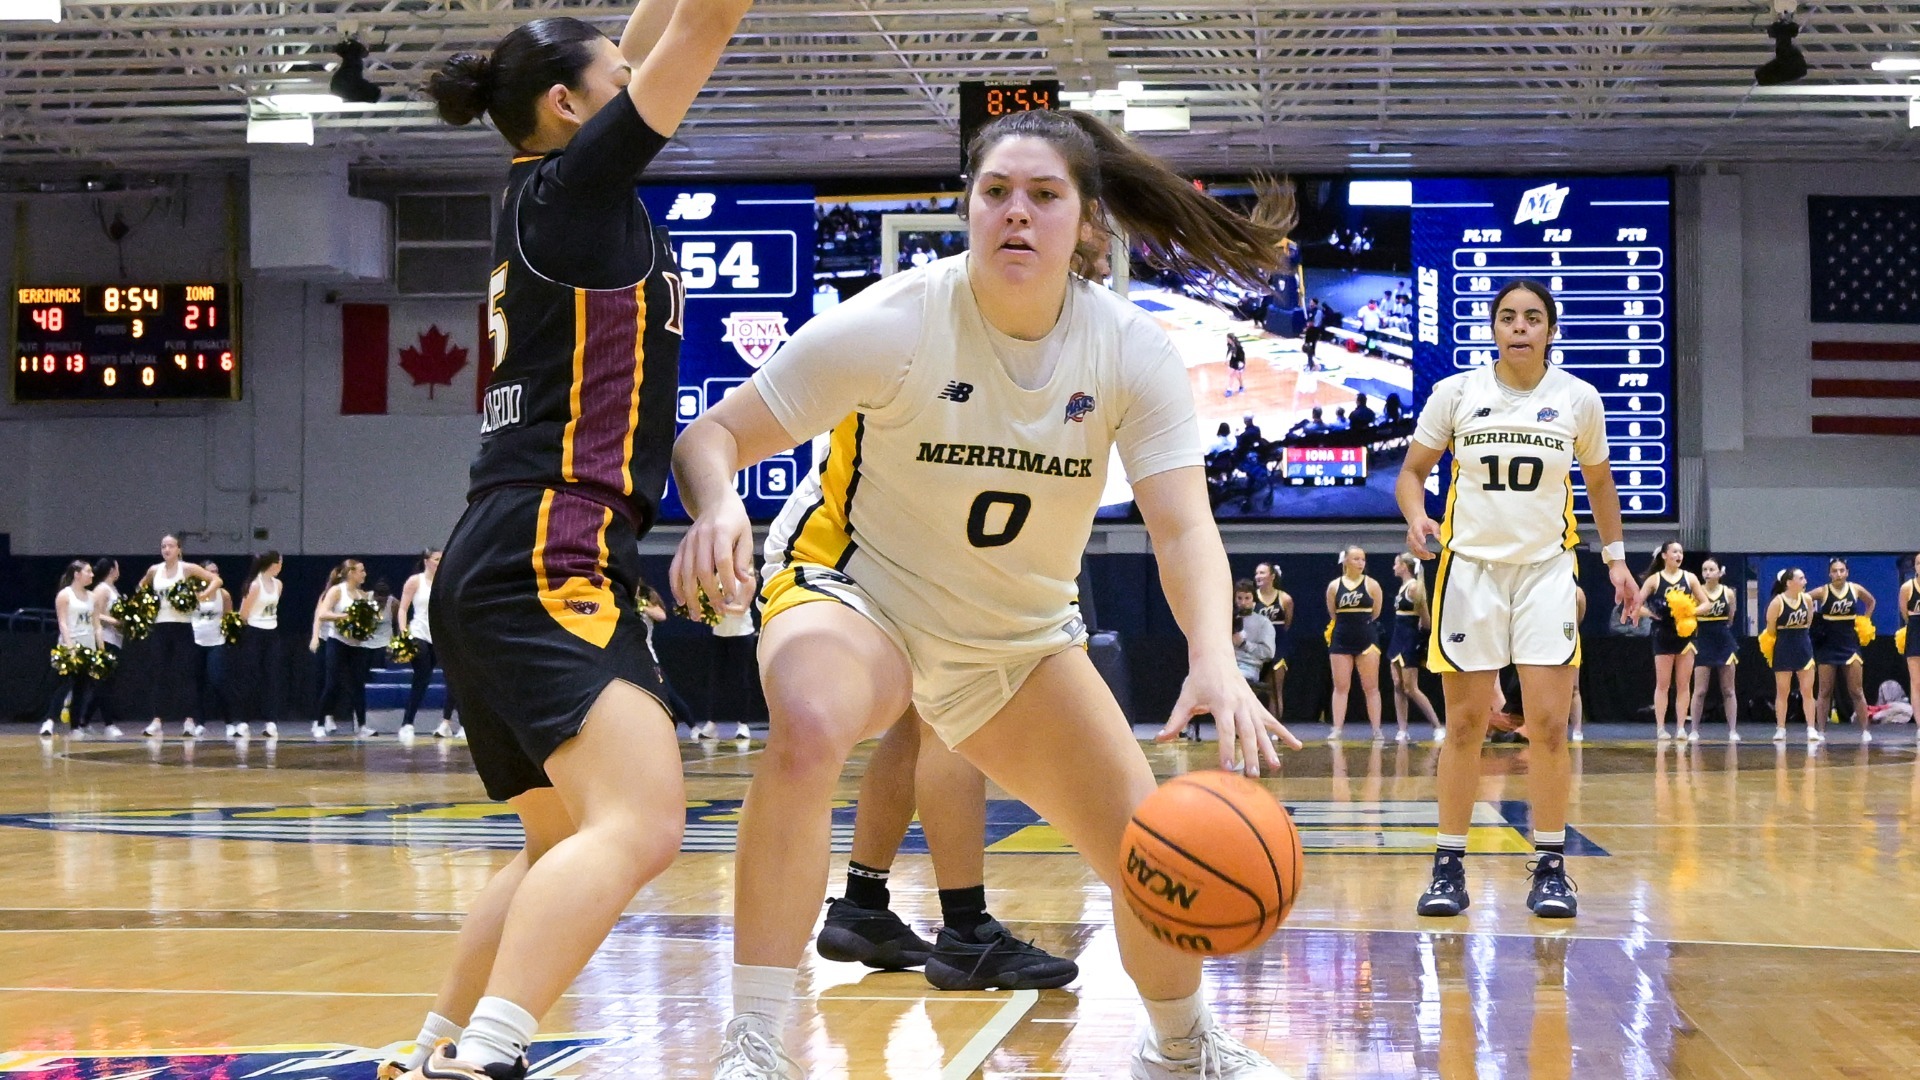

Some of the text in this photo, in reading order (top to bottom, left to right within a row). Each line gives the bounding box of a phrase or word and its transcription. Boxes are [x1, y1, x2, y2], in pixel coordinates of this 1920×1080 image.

[987, 89, 1049, 116] 8:54
[1462, 228, 1648, 243] PLYR FLS PTS
[1474, 251, 1639, 267] 0 1 7
[186, 286, 214, 301] IONA
[1470, 277, 1491, 292] 10
[105, 287, 158, 312] 8:54
[1418, 266, 1439, 346] HOME
[33, 308, 62, 331] 48
[185, 306, 215, 330] 21
[132, 319, 143, 338] 3
[731, 322, 782, 337] IONA
[174, 354, 187, 370] 4
[220, 352, 233, 371] 6
[104, 367, 154, 386] 0 0
[1618, 373, 1649, 387] PTS
[1628, 396, 1641, 411] 4
[1463, 432, 1565, 451] MERRIMACK
[916, 442, 1093, 478] MERRIMACK
[1305, 449, 1355, 461] IONA 21
[768, 468, 786, 491] 3
[1305, 464, 1357, 476] MC 48
[1480, 455, 1544, 491] 10
[1629, 496, 1642, 511] 4
[967, 490, 1031, 548] 0
[1126, 845, 1200, 910] NCAA
